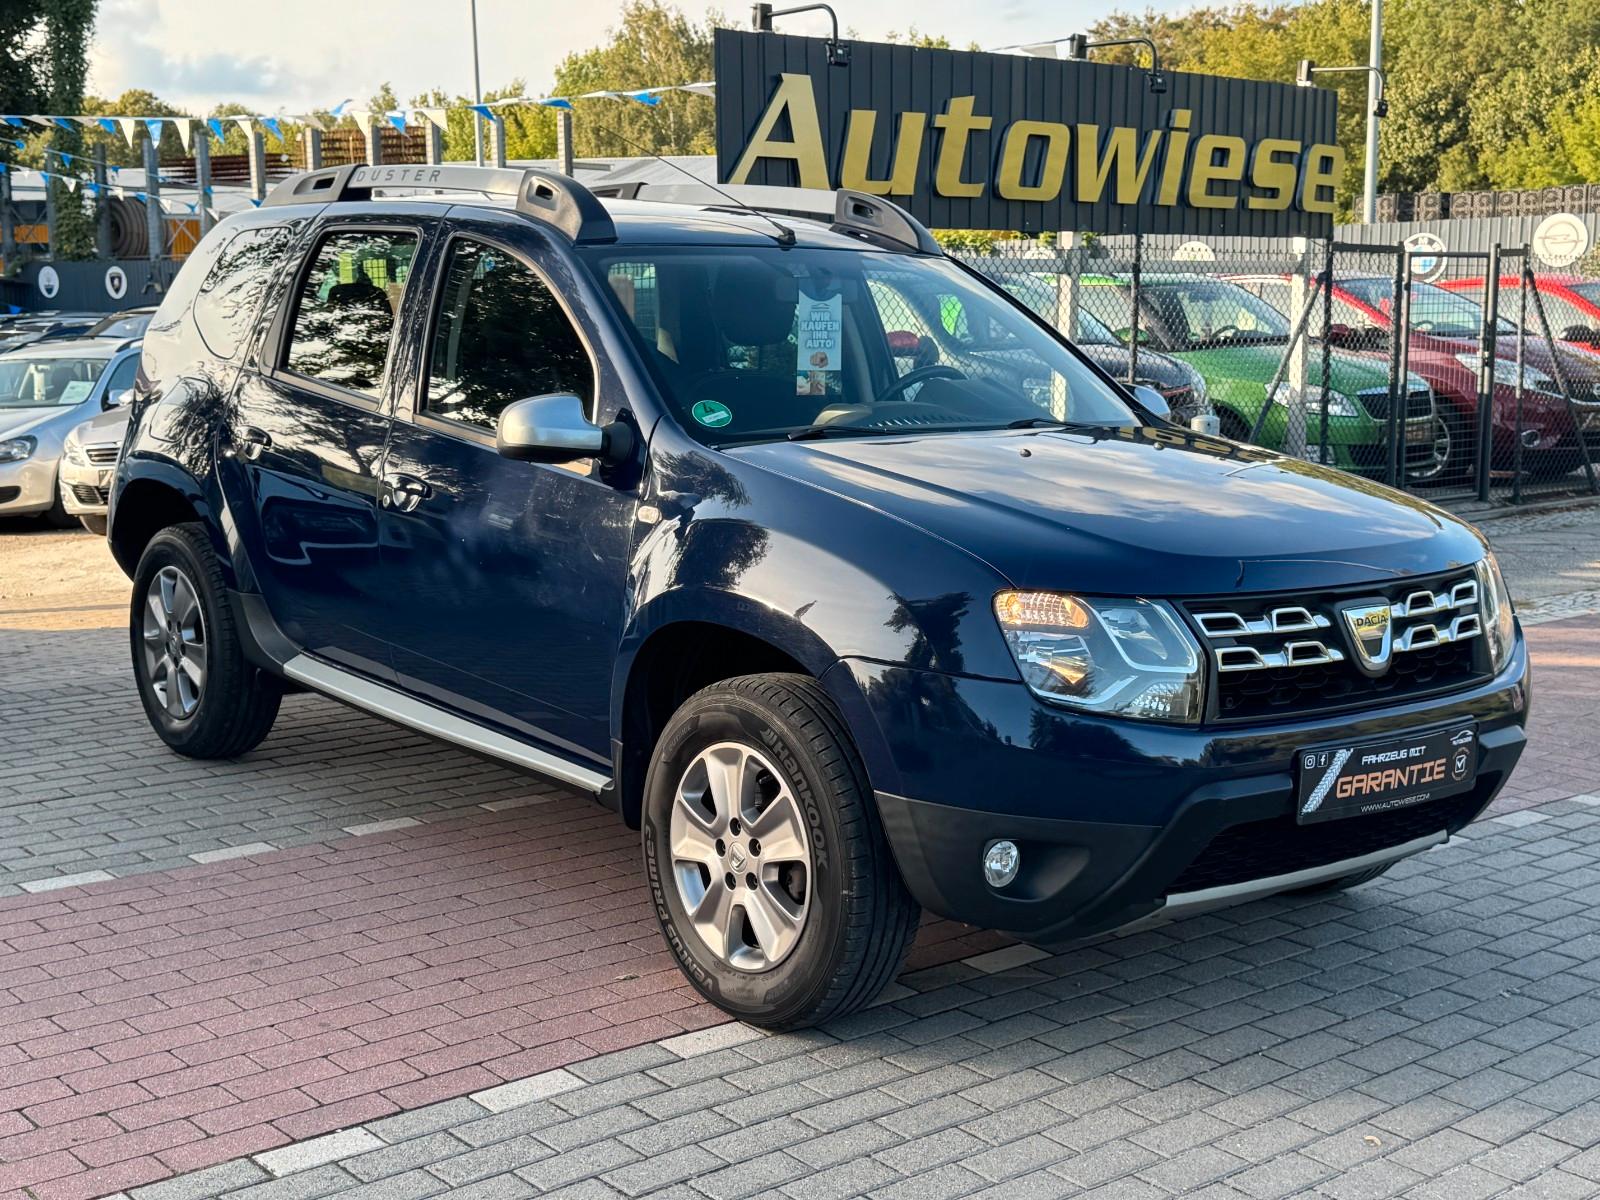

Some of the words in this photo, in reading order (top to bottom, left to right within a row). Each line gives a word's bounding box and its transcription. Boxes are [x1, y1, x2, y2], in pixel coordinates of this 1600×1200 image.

[727, 72, 1344, 214] Autowiese
[356, 169, 441, 182] DUSTER
[810, 311, 831, 321] WIR
[800, 321, 840, 331] KAUFEN
[812, 331, 828, 340] IHR
[1356, 615, 1387, 627] DACIA
[1361, 749, 1407, 766] FAHRZEUG
[1408, 745, 1427, 758] MIT
[1335, 757, 1447, 799] GARANTIE
